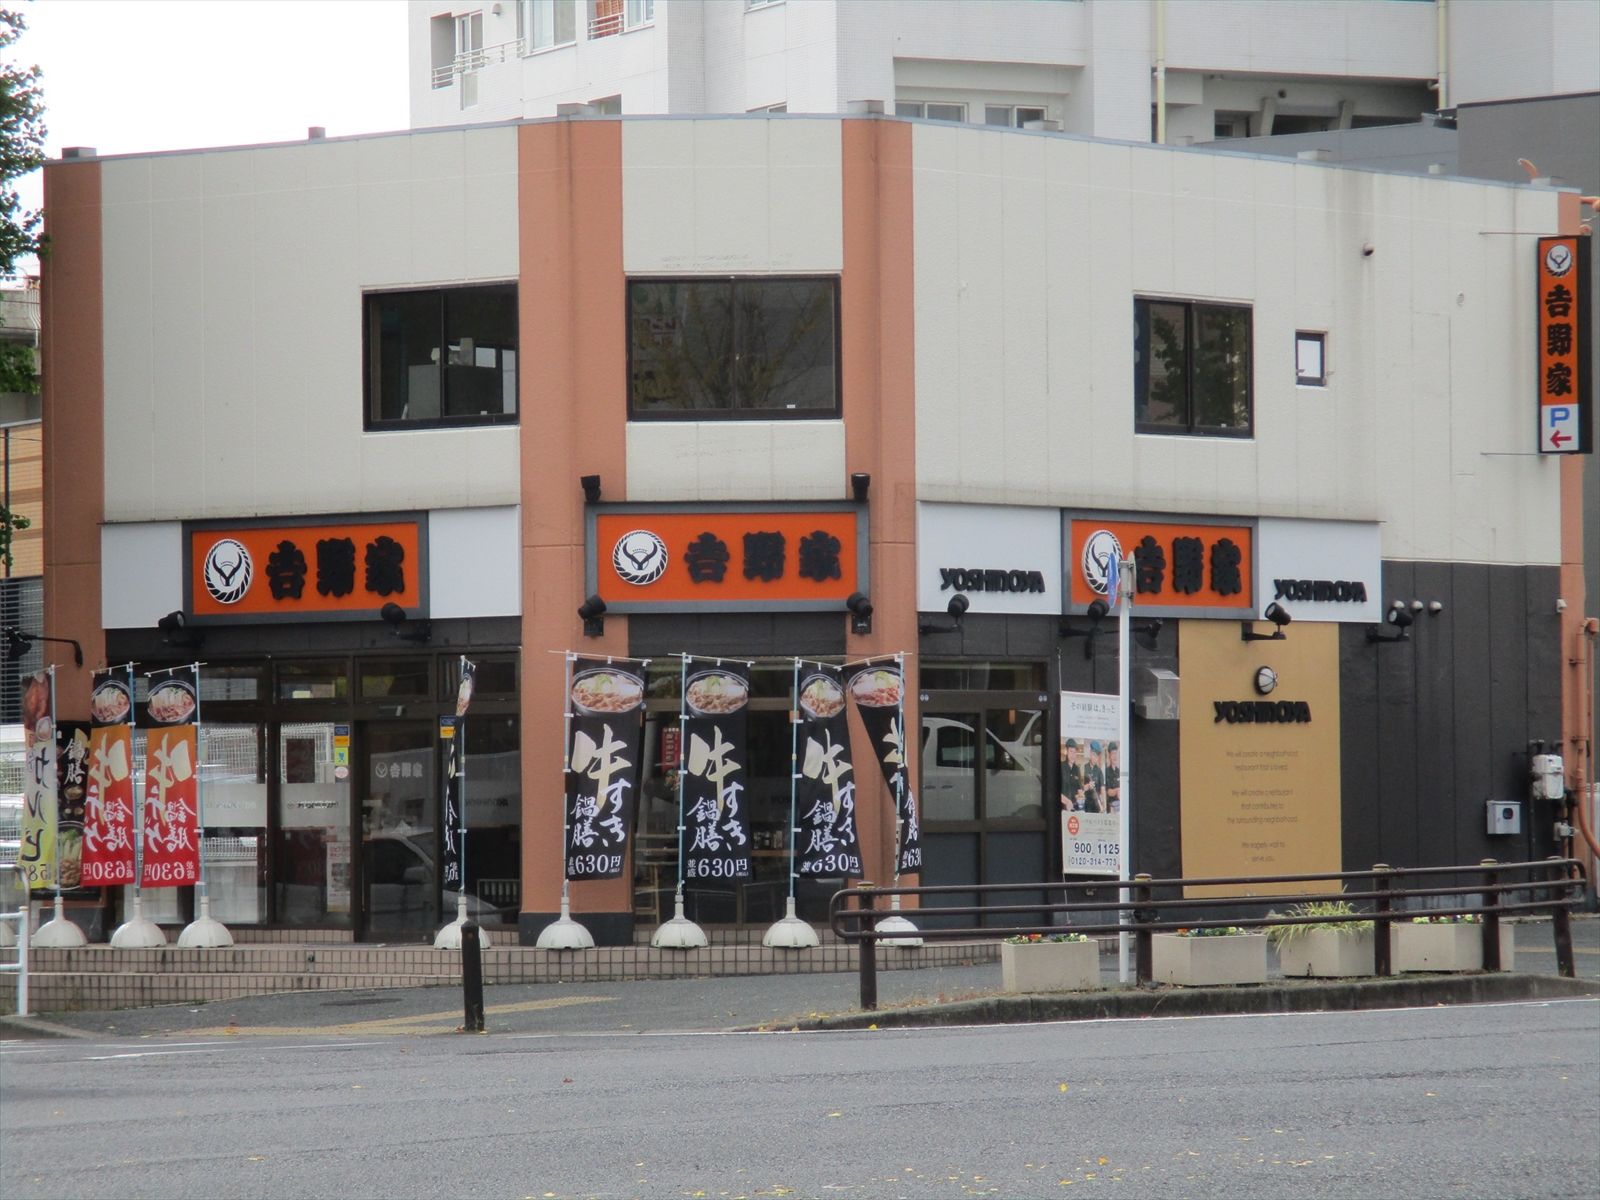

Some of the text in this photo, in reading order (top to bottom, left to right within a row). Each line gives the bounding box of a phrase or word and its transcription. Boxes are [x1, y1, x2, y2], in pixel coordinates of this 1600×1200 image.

[1545, 285, 1572, 396] 吉野家
[1550, 407, 1570, 427] P
[684, 530, 842, 583] 吉野家
[1074, 842, 1092, 853] 900
[1098, 843, 1120, 855] 1125
[697, 857, 748, 878] 630円
